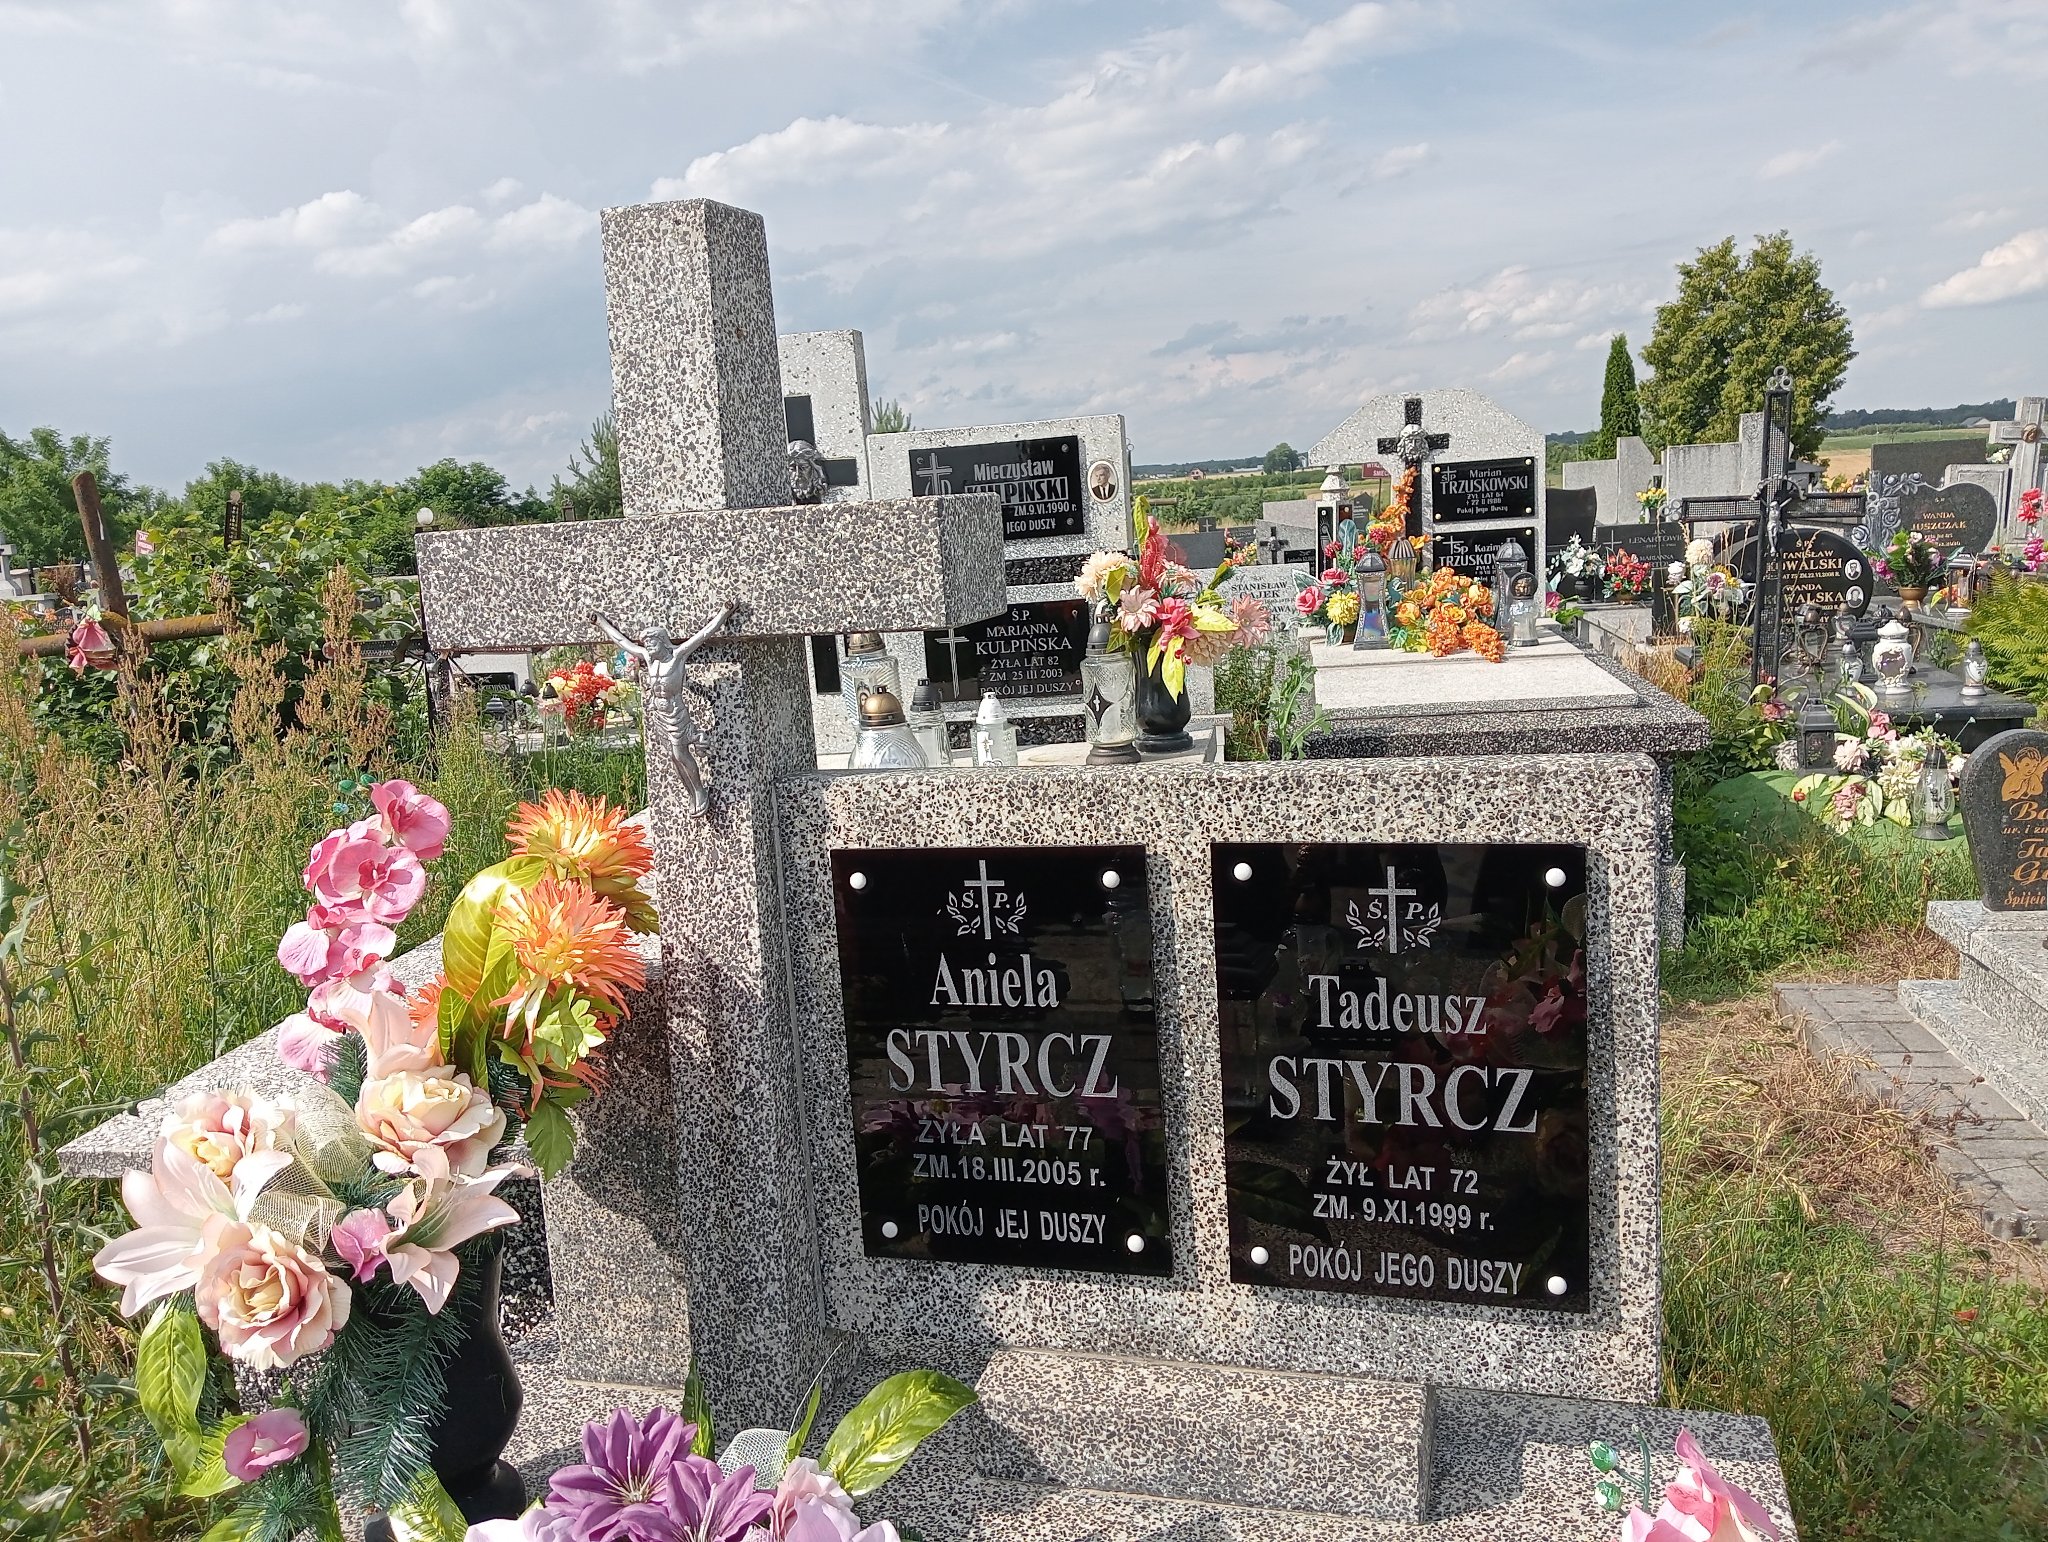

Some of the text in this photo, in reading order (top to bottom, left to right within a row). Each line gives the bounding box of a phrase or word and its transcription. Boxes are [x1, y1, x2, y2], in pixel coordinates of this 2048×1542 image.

[973, 458, 1054, 482] Mieczysław
[1469, 468, 1502, 478] Marian
[1440, 475, 1528, 495] TRZUSKOWSKI
[1014, 501, 1070, 517] ZM.9.VI.1990
[1922, 511, 1956, 520] WANDA
[1006, 518, 1056, 534] JEGO DUSZY
[1231, 581, 1288, 592] STANISŁAW
[1786, 583, 1823, 591] WANDA
[986, 623, 1059, 638] MARIANNA
[975, 634, 1073, 656] KULPIŃSKA
[991, 656, 1059, 669] ŻYŁA LAT 82
[1012, 670, 1023, 681] 25
[1026, 669, 1038, 680] III
[1040, 668, 1063, 679] 2003
[1017, 684, 1034, 696] JEJ
[1036, 682, 1073, 694] DUSZY
[929, 952, 1060, 1008] Aniela
[1308, 973, 1488, 1036] Tadeusz
[886, 1028, 1119, 1099] STYRCZ
[1268, 1054, 1539, 1134] STYRCZ
[1000, 1122, 1049, 1149] LAT
[1063, 1126, 1093, 1151] 77
[913, 1153, 1106, 1187] ZM.18.III.2005 r.
[1326, 1154, 1479, 1194] ŻYŁ LAT 72
[918, 1199, 1106, 1244] POKÓJ JEJ DUSZY
[1479, 1211, 1495, 1231] r.
[1289, 1240, 1523, 1295] POKÓJ JEGO DUSZY
